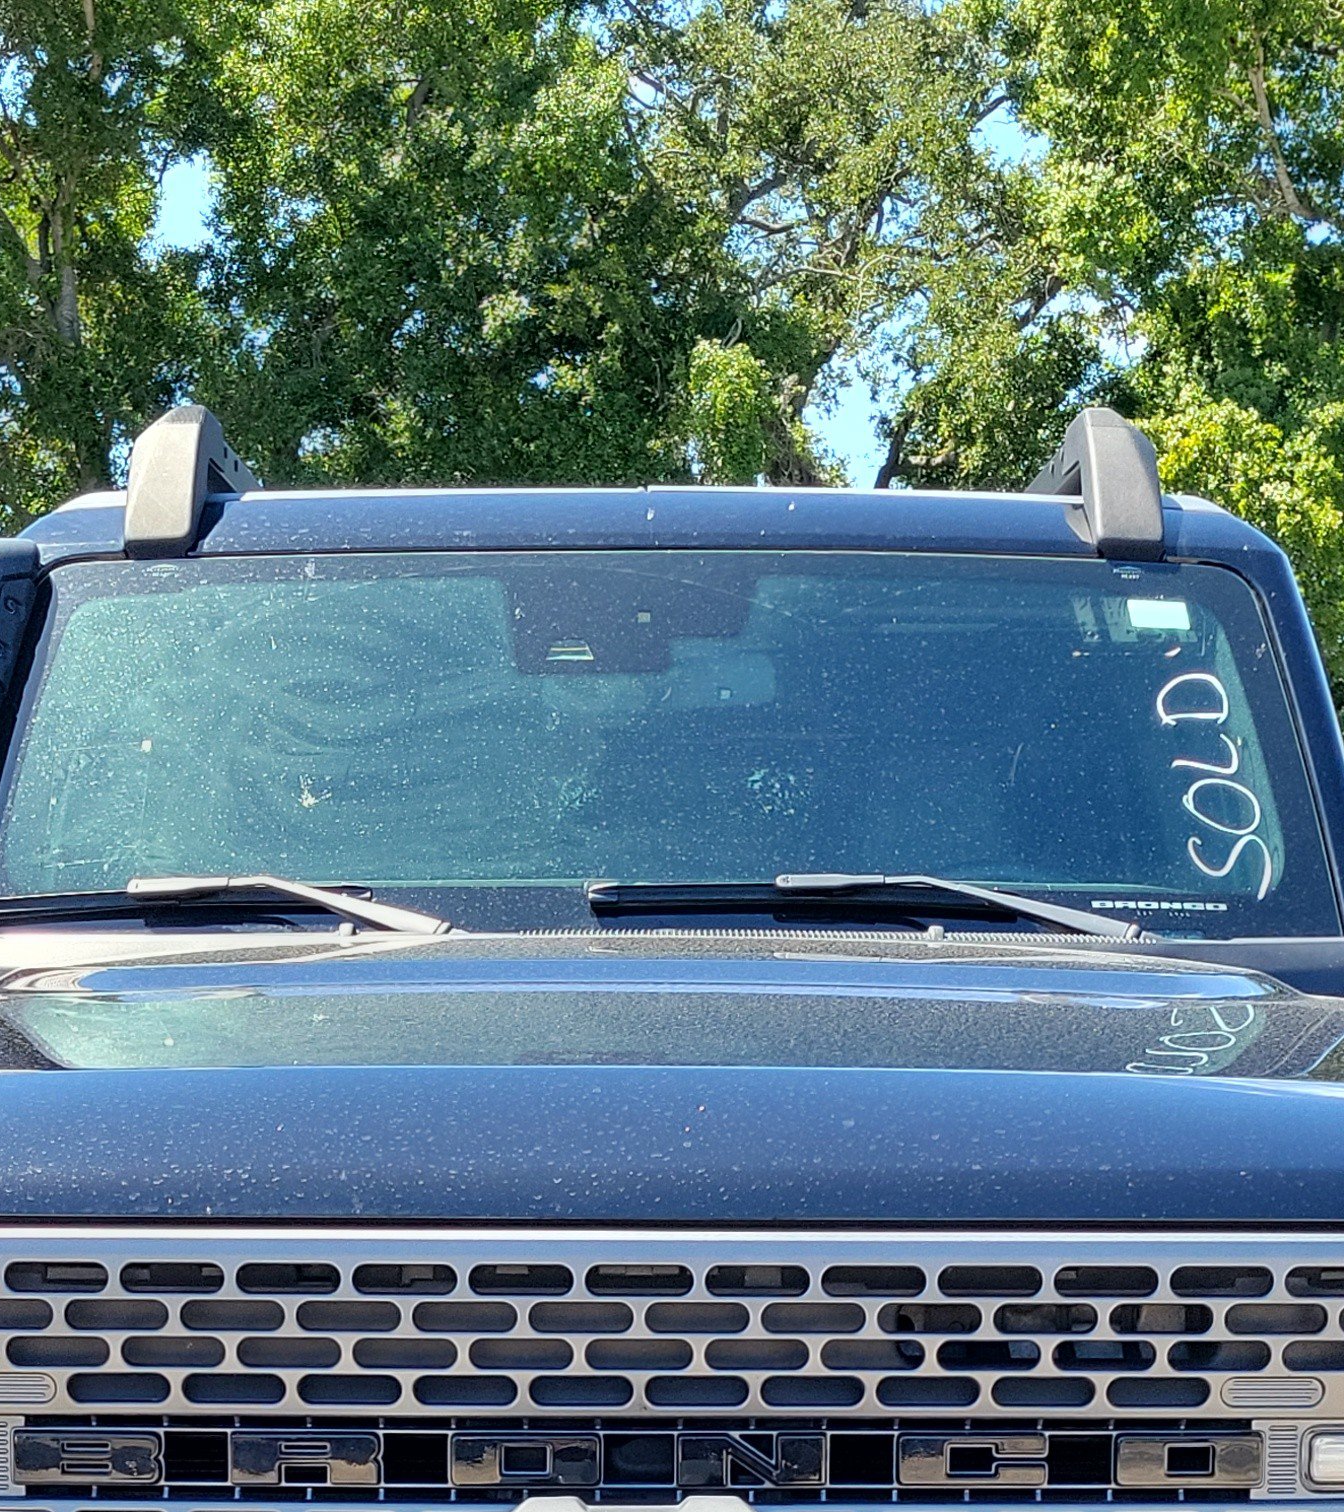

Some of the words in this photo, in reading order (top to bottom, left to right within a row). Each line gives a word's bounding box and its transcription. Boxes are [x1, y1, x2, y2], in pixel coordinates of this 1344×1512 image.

[1156, 672, 1272, 900] SOLD
[1090, 900, 1228, 911] BRONCO
[13, 1430, 1262, 1486] BRONCO
